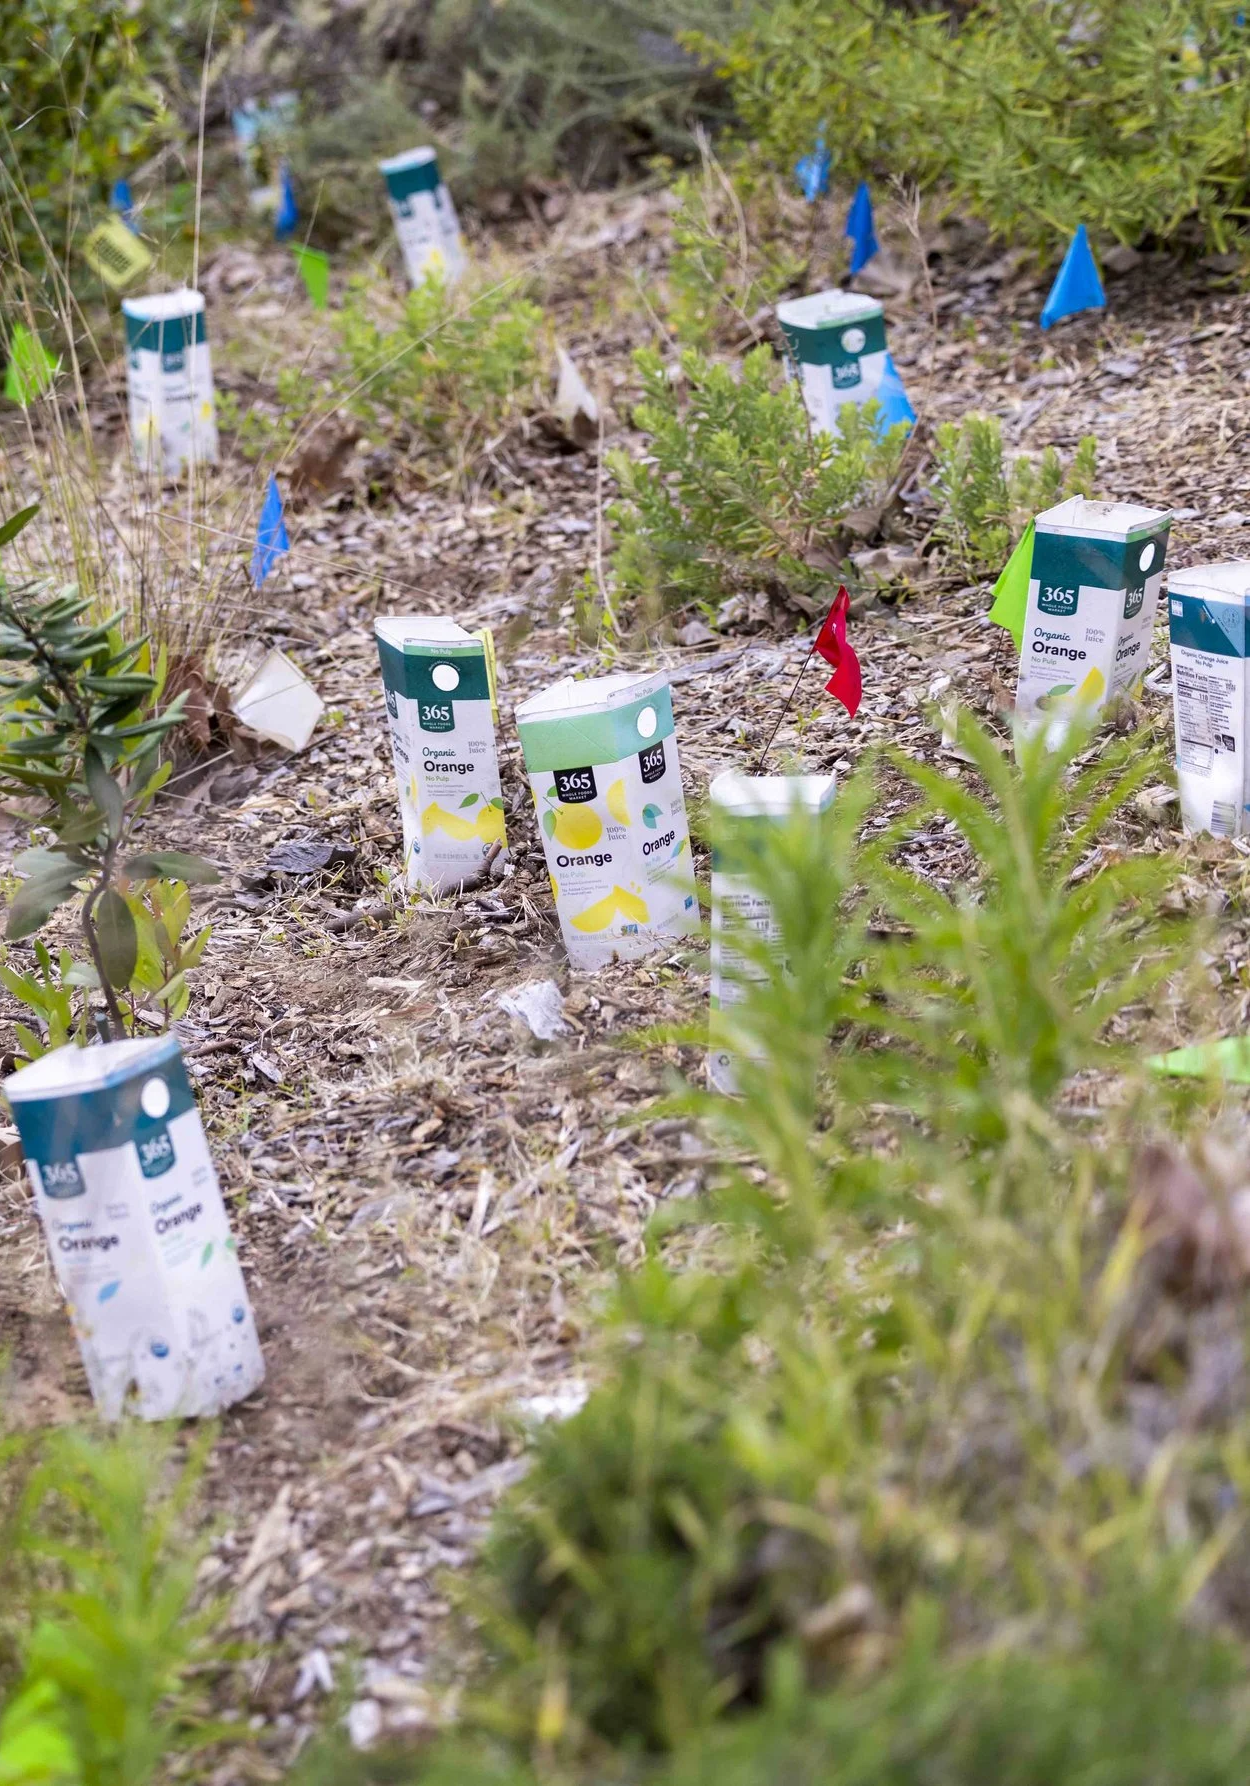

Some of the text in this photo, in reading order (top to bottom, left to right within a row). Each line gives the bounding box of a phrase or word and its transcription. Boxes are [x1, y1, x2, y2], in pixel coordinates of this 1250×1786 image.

[1041, 587, 1075, 605] 365
[1125, 587, 1143, 608] 365
[1033, 627, 1071, 642] Organic
[1084, 634, 1104, 644] Juice
[1085, 627, 1106, 637] 100%
[1031, 640, 1087, 661] Orange
[1115, 641, 1141, 662] Orange
[1031, 655, 1057, 666] No Pulp
[1198, 653, 1215, 662] Orange
[1215, 657, 1229, 665] Juice
[1202, 660, 1213, 669] Pulp
[1195, 673, 1208, 681] Facts
[634, 691, 644, 699] No
[421, 704, 450, 721] 365
[422, 746, 457, 760] Organic
[468, 747, 487, 755] Juice
[423, 760, 475, 775] Orange
[642, 748, 663, 773] 365
[436, 775, 450, 783] Pulp
[559, 772, 592, 792] 365
[606, 826, 627, 834] 100%
[607, 833, 627, 842] Juice
[642, 830, 675, 856] Orange
[556, 853, 613, 868] Orange
[559, 870, 586, 880] No Pulp
[139, 1133, 171, 1168] 365
[41, 1162, 78, 1187] 365
[155, 1202, 203, 1235] Orange
[58, 1233, 120, 1251] Orange
